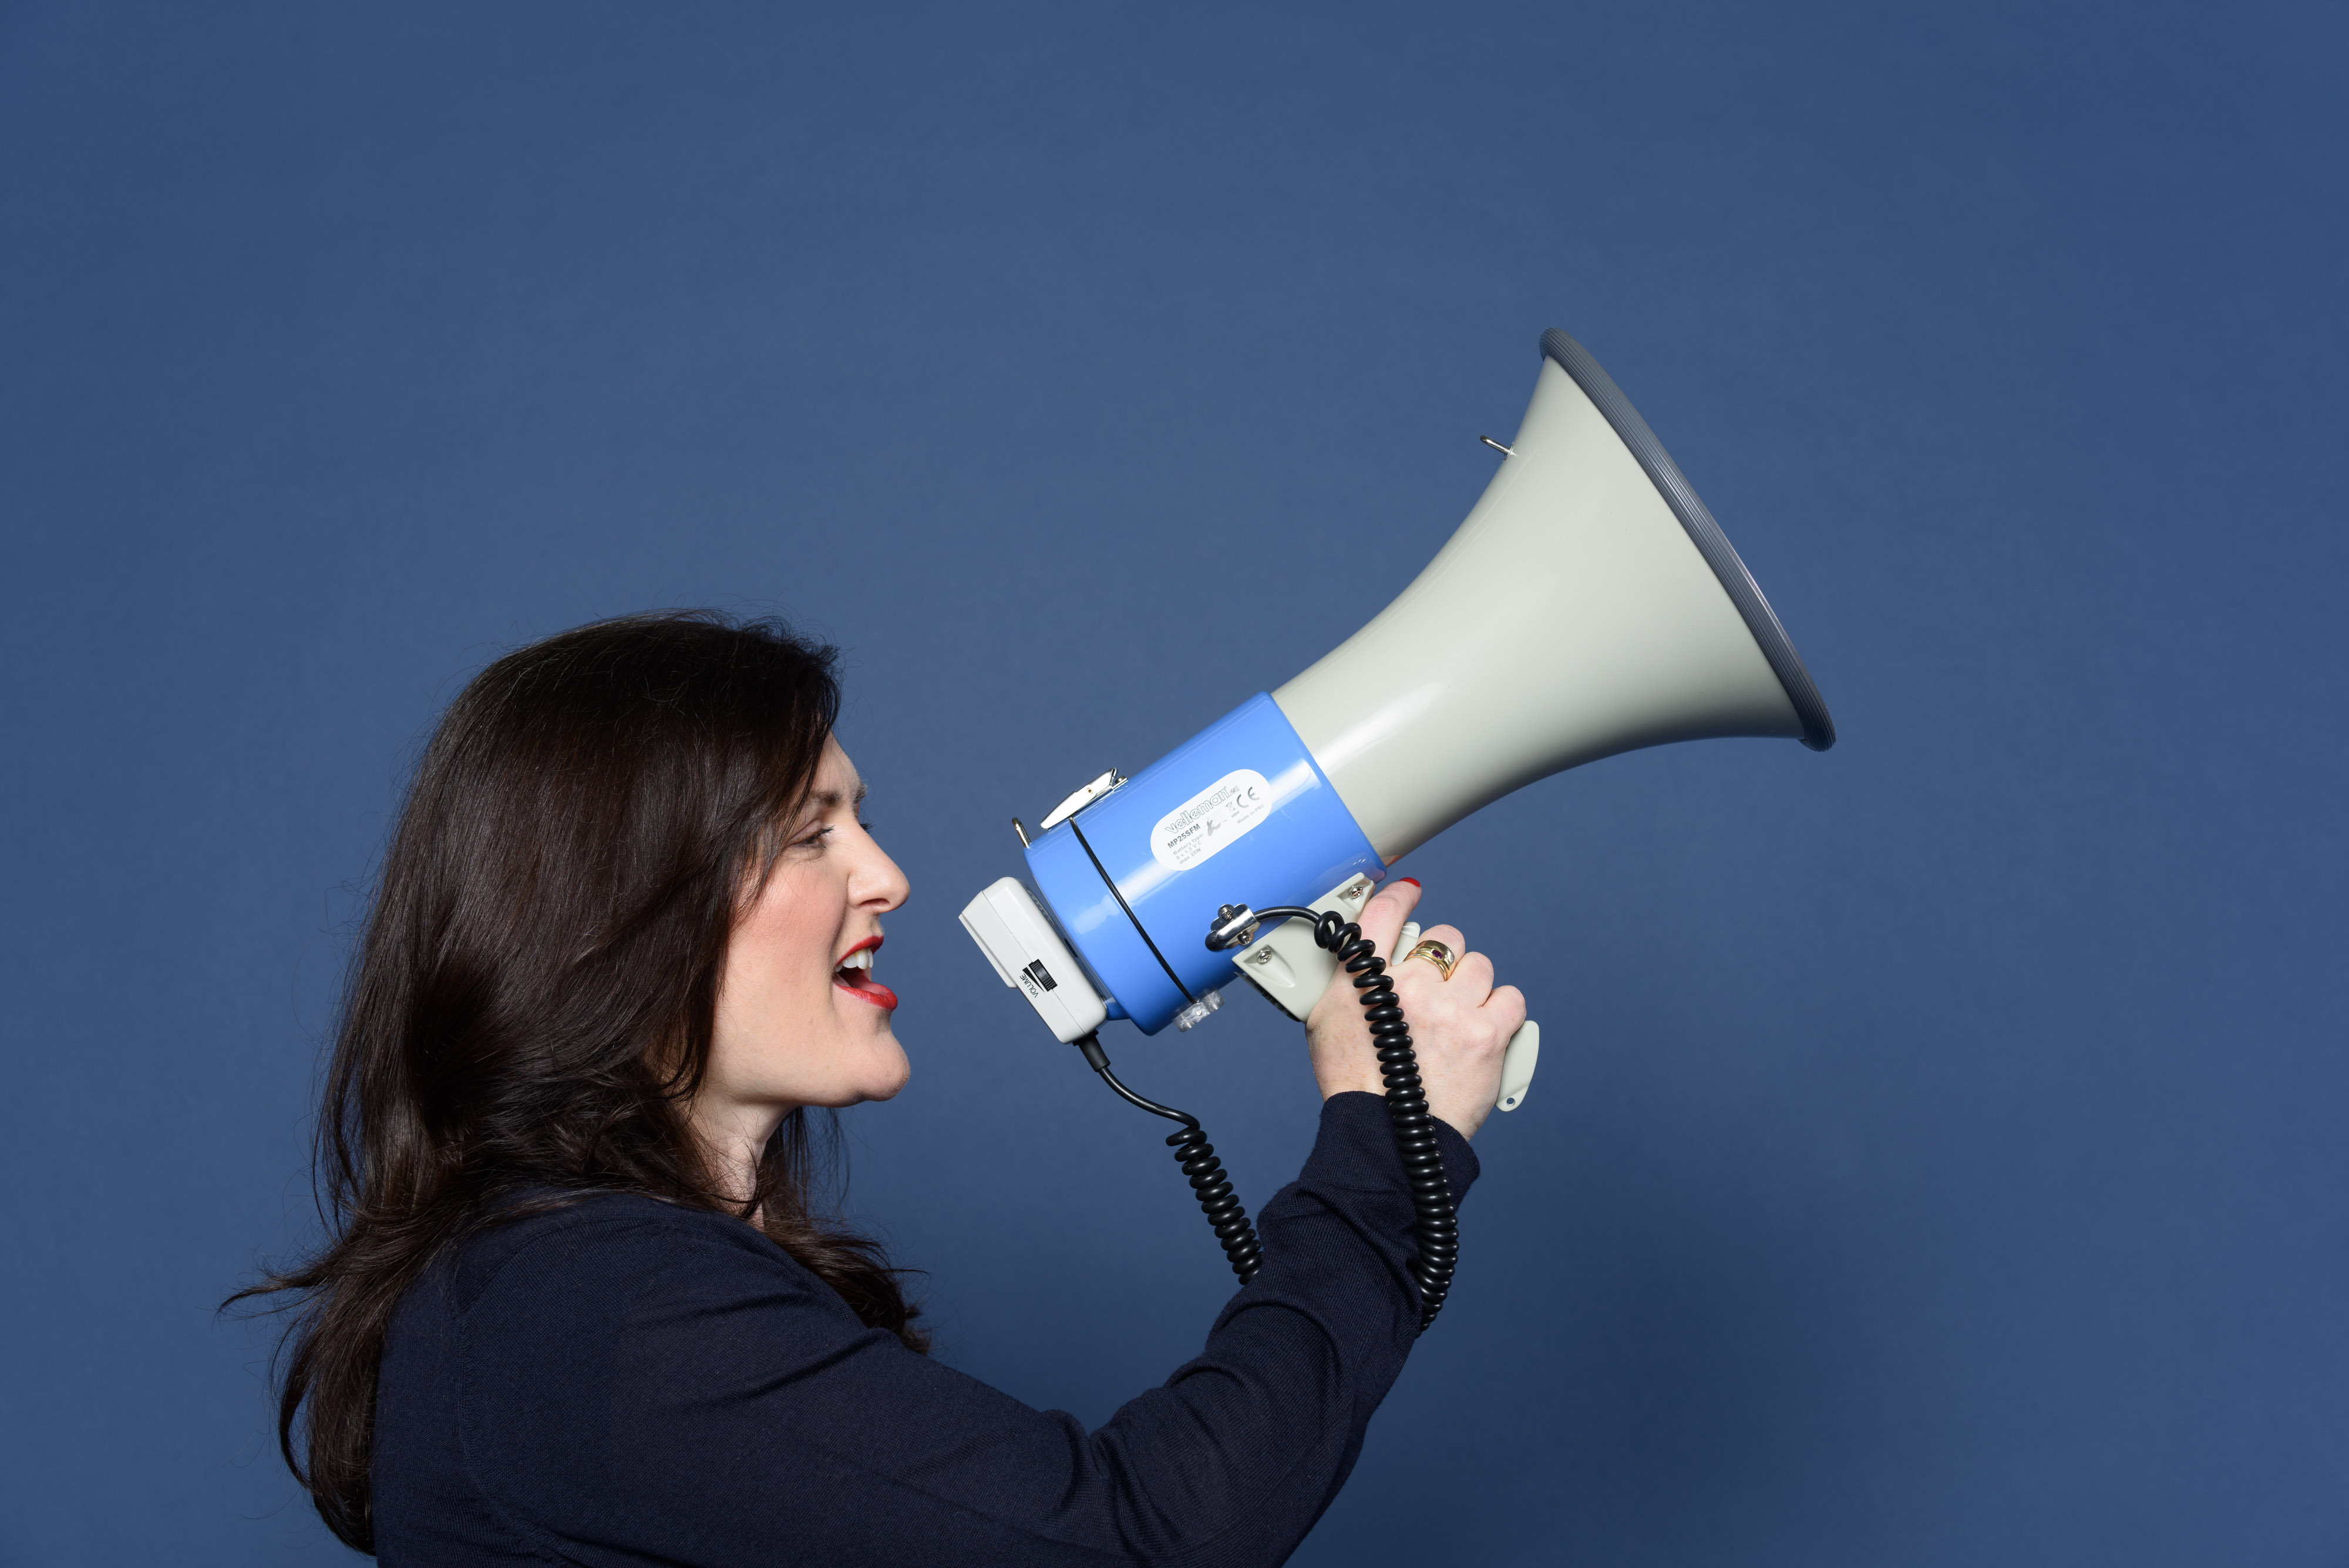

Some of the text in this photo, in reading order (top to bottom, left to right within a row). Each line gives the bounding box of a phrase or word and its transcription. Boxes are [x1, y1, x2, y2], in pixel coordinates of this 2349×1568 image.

[1237, 815, 1249, 824] Made
[1167, 823, 1200, 849] MP25SFM
[1173, 842, 1191, 855] Battery
[1179, 847, 1201, 864] max 25W
[1019, 973, 1038, 998] VOLUME
